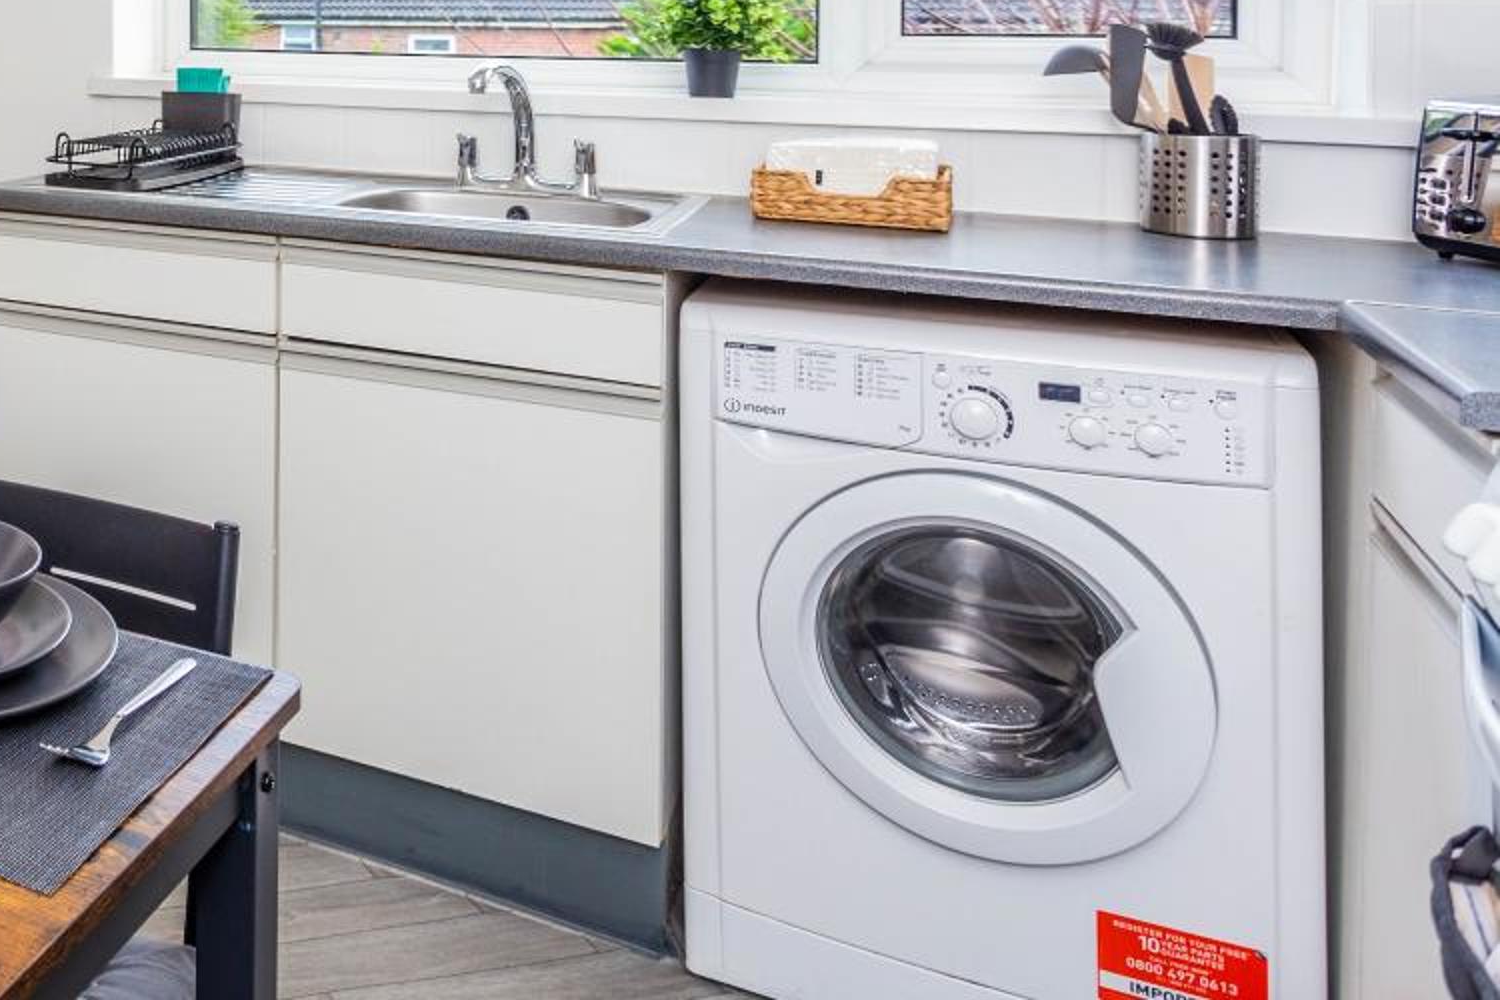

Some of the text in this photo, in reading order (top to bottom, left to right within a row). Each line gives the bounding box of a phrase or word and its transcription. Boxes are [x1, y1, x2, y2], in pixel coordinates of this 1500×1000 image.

[1112, 918, 1163, 938] REGISTER
[1165, 932, 1187, 945] FOR
[1188, 938, 1218, 954] YOUR
[1138, 935, 1160, 954] 10
[1161, 941, 1188, 954] YEAR
[1125, 956, 1163, 976] 0800
[1198, 975, 1239, 997] 0613
